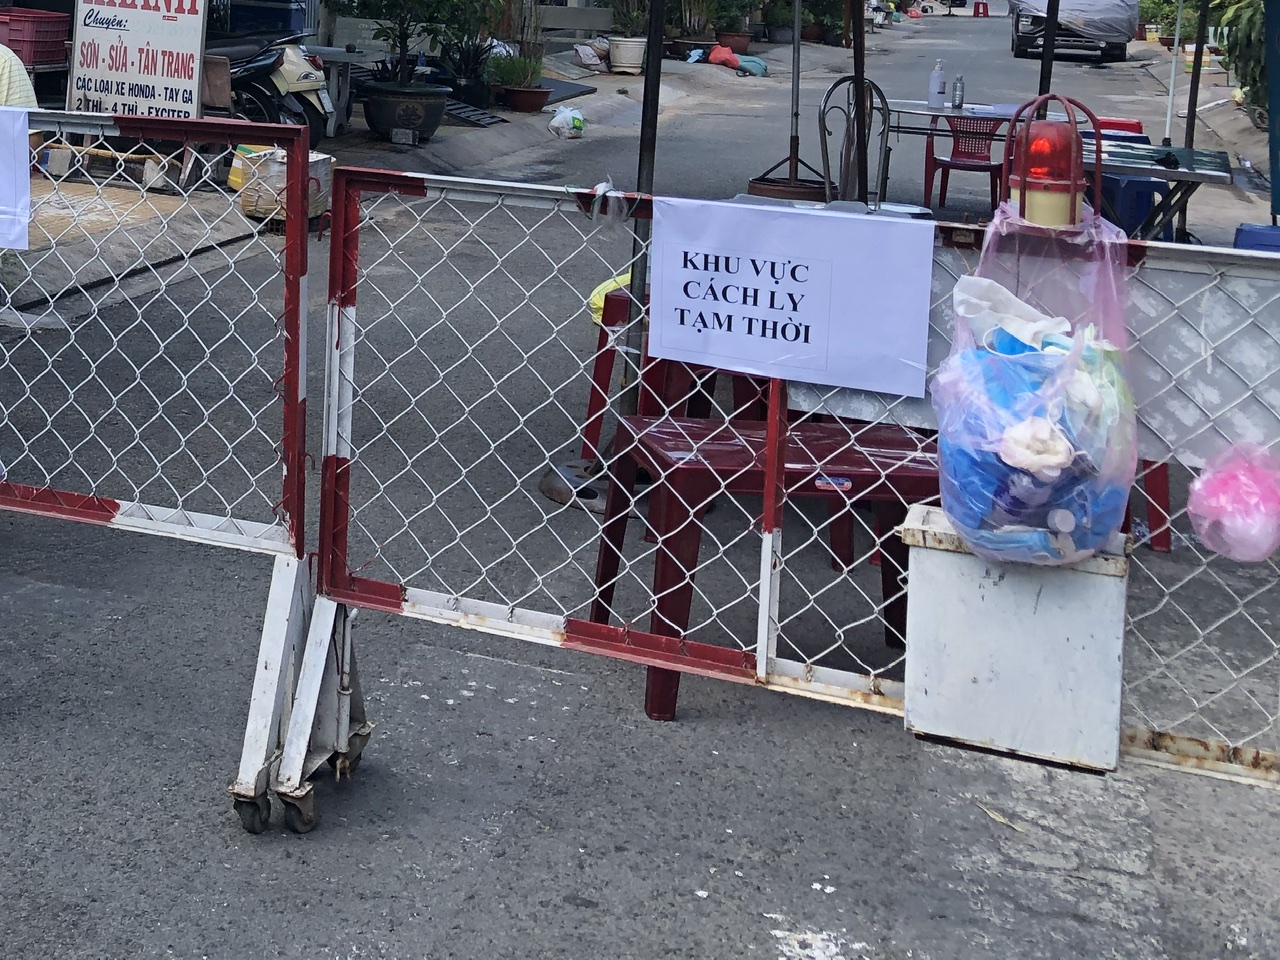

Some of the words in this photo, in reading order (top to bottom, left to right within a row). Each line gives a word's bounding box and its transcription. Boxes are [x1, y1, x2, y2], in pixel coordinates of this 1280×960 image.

[83, 8, 128, 29] Chuyên:
[79, 38, 100, 69] SƠN
[108, 34, 128, 73] SỬA
[138, 40, 158, 76] TÂN
[161, 50, 195, 80] TRANG
[76, 73, 92, 92] CÁC
[94, 79, 113, 97] LOẠI
[115, 81, 126, 96] XE
[128, 82, 156, 100] HONDA
[163, 86, 180, 103] TAY
[182, 89, 193, 104] GA
[76, 98, 82, 111] 2
[86, 97, 102, 113] THÌ
[111, 102, 118, 114] 4
[121, 101, 138, 116] THÌ
[681, 250, 741, 274] KHU
[749, 258, 810, 285] VỰC
[682, 278, 760, 307] CÁCH
[768, 290, 806, 313] LY
[674, 307, 734, 333] TẠM
[742, 317, 812, 344] THỜI
